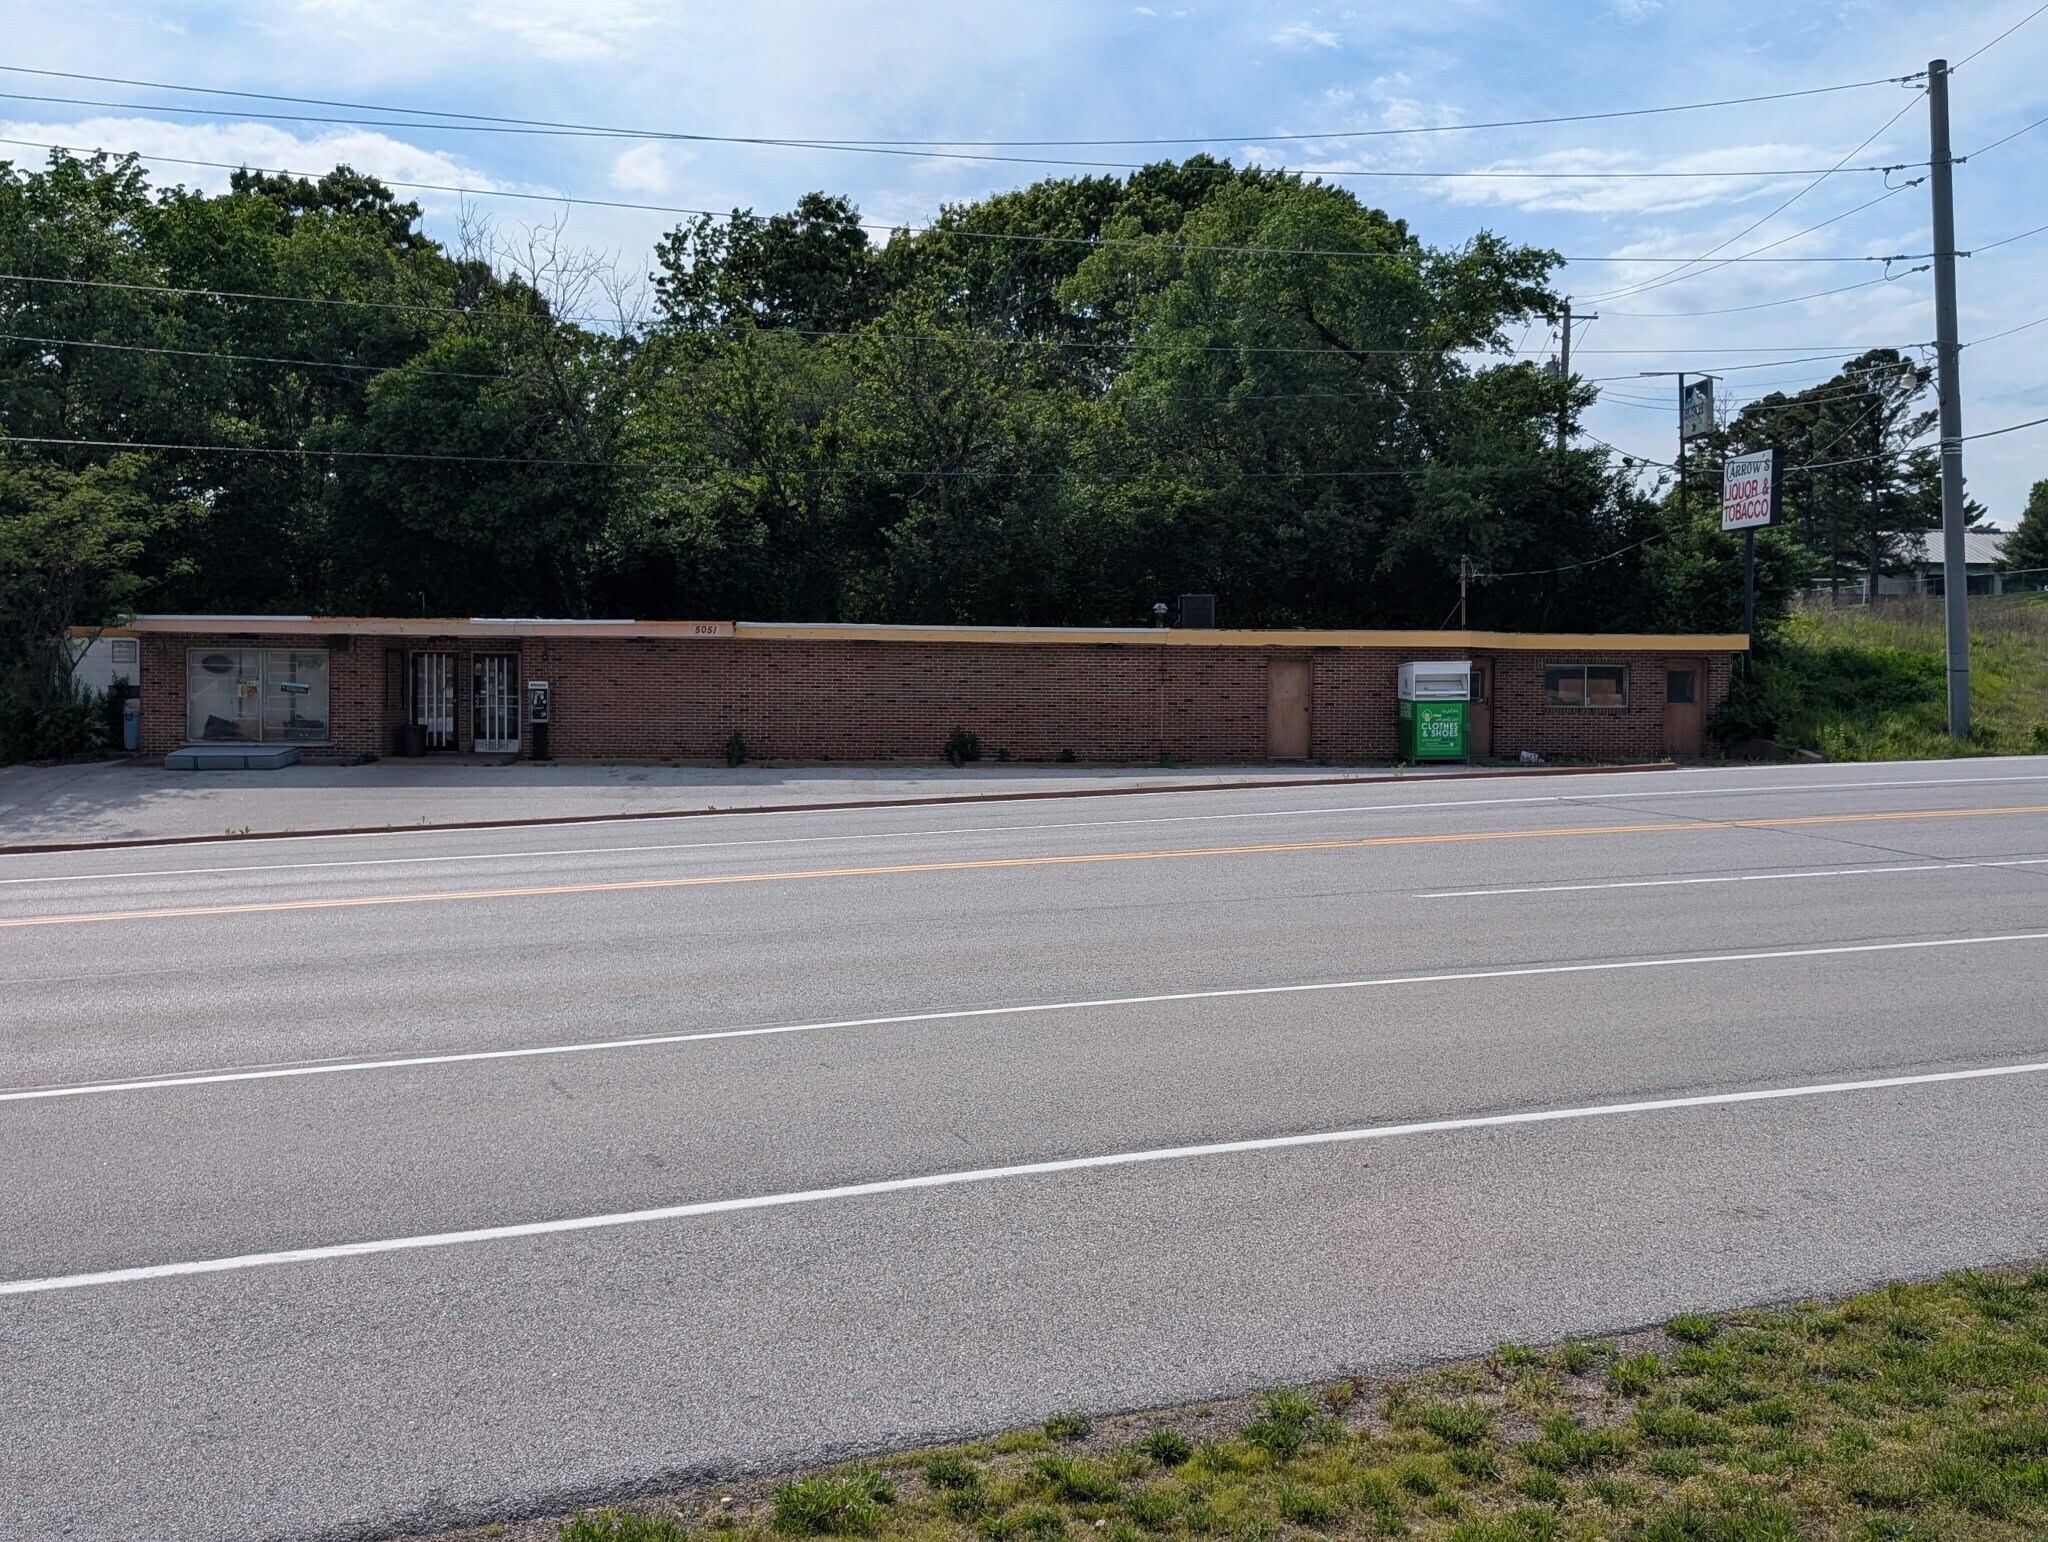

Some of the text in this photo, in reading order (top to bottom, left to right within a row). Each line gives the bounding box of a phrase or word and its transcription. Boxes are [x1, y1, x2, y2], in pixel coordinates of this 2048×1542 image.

[1725, 477, 1769, 502] LIQUOR &
[1724, 499, 1768, 522] TOBACCO
[695, 625, 717, 634] 5051
[1421, 722, 1459, 730] CLOTHES
[1431, 729, 1459, 737] SHOES
